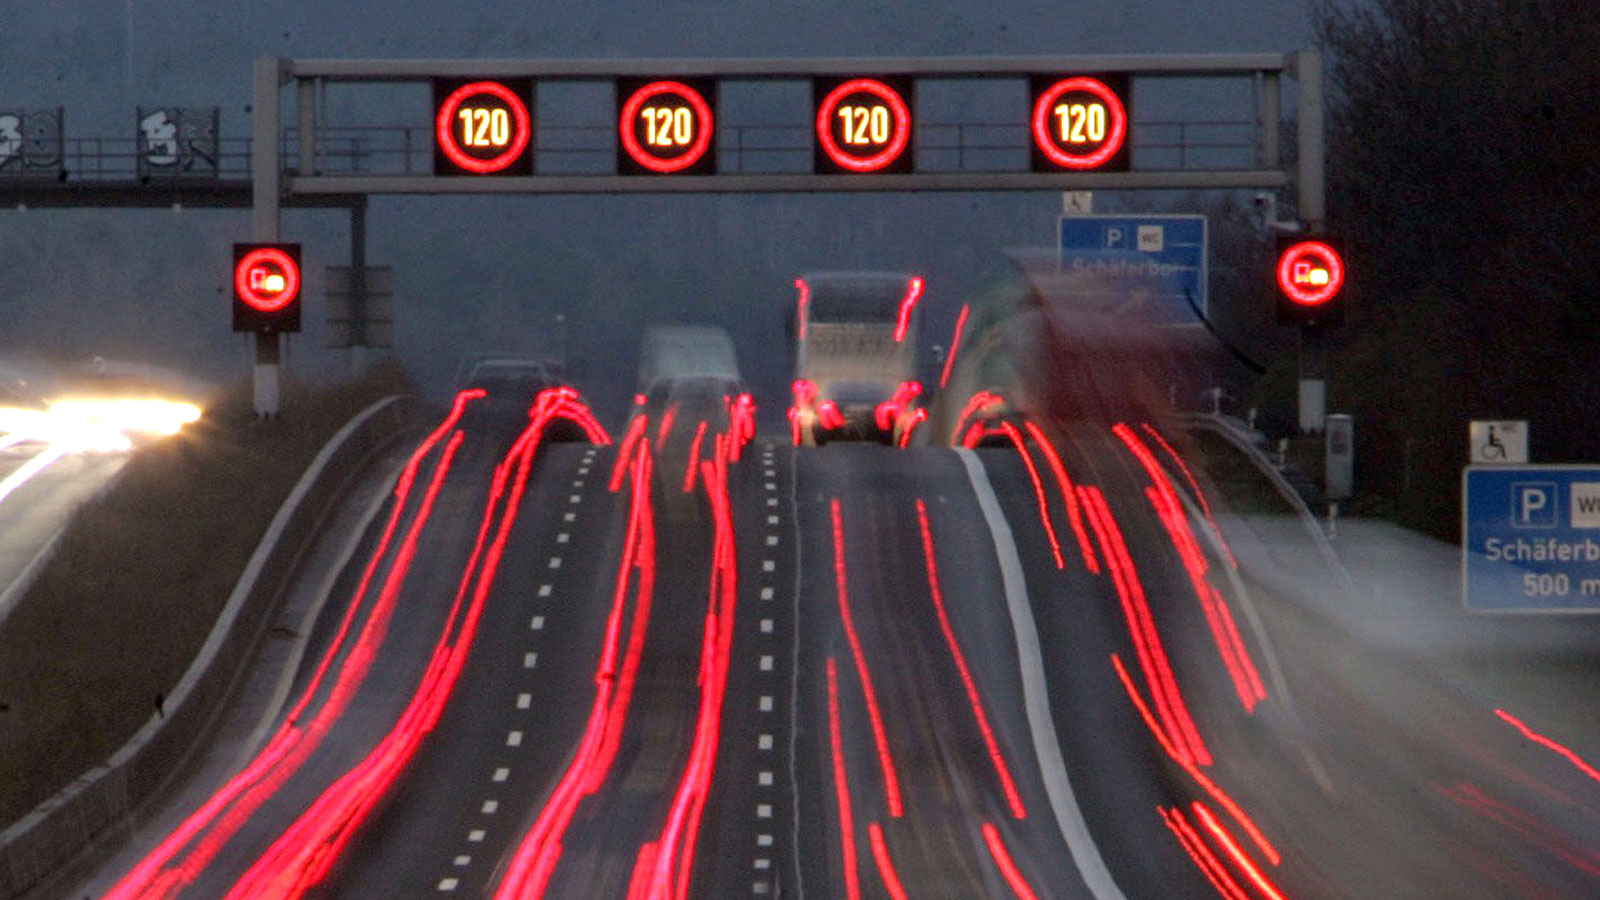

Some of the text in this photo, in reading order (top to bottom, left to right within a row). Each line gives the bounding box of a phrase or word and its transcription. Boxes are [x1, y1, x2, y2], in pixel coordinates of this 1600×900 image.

[458, 107, 510, 147] 120
[640, 105, 692, 146] 120
[837, 104, 889, 145] 120
[1054, 102, 1106, 143] 120
[1106, 228, 1122, 249] P
[1521, 487, 1547, 523] P
[1484, 536, 1600, 562] Schäferb
[1523, 573, 1600, 597] 500 m
